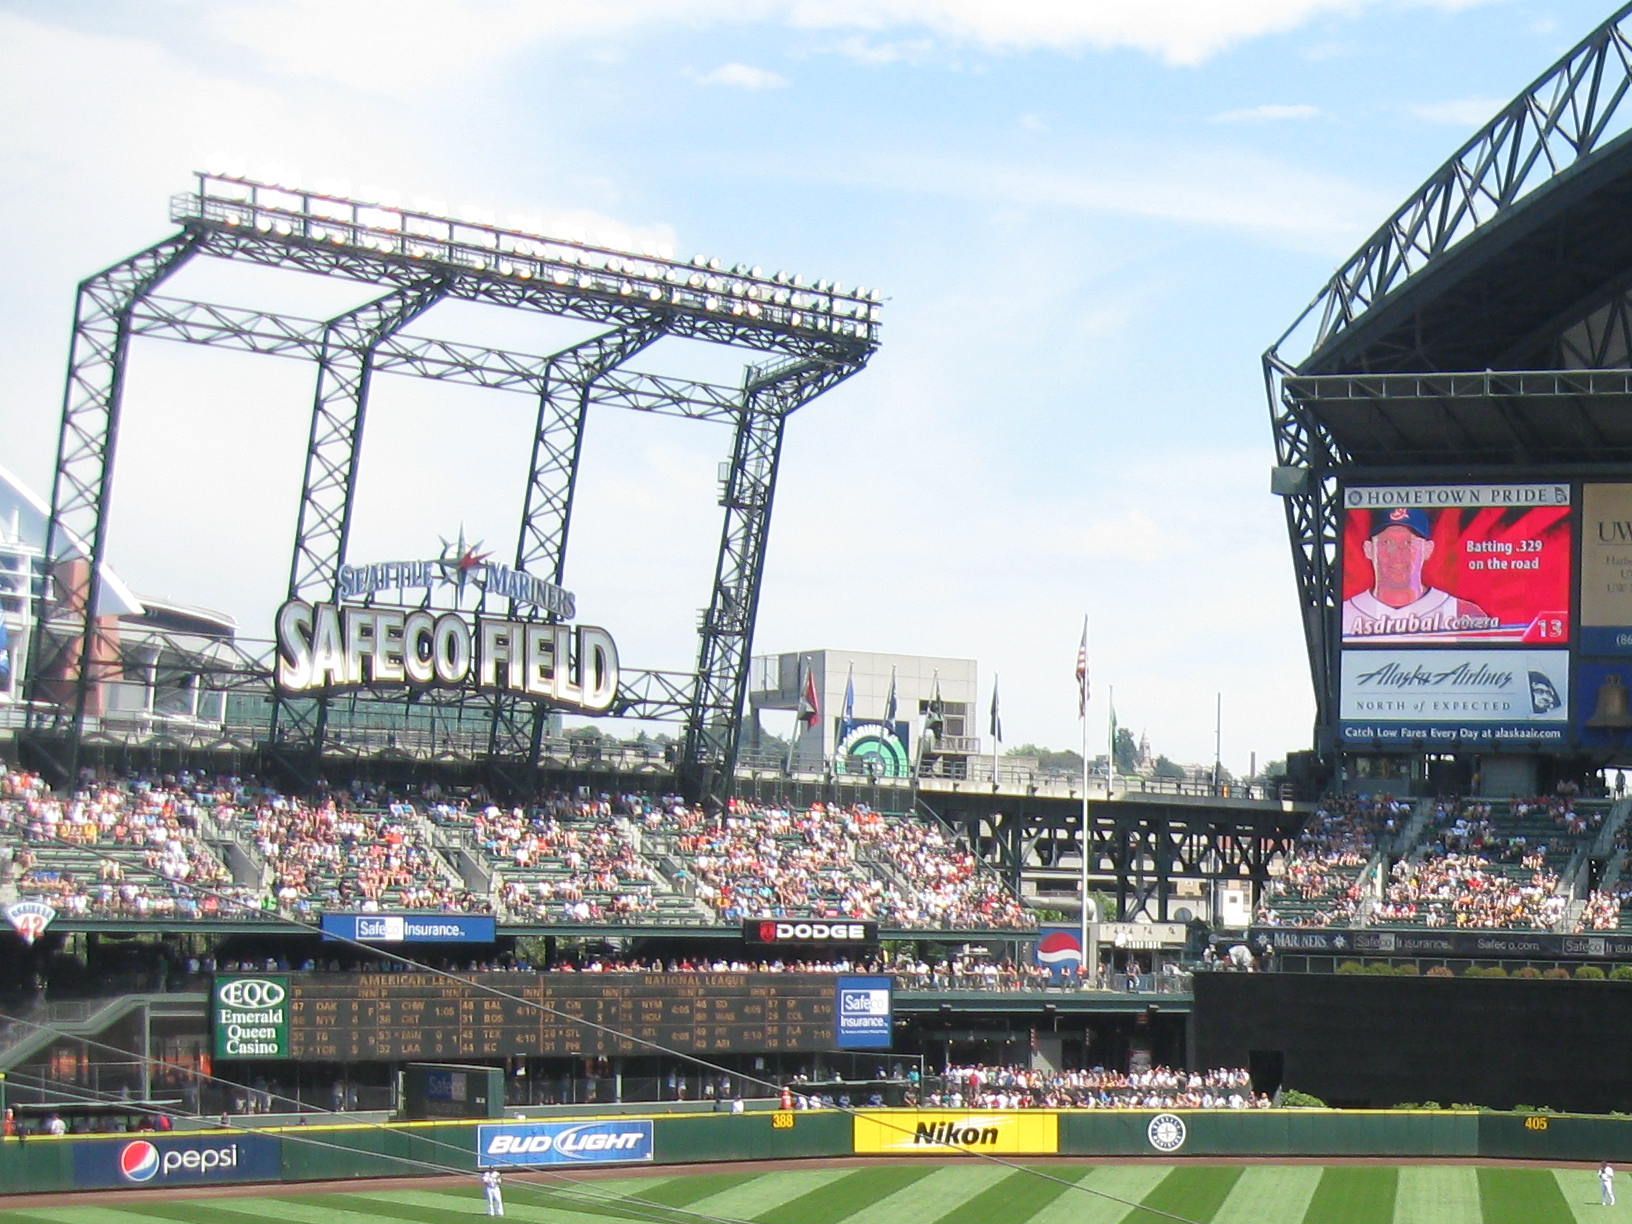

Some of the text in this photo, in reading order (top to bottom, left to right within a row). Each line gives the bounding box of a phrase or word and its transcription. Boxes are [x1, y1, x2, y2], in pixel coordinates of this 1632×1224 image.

[1368, 488, 1548, 505] HOMETOWN PRIDE
[1466, 540, 1543, 556] Batting .329
[1468, 558, 1539, 570] on the road
[338, 560, 576, 620] SEATTLE MARINERS
[1351, 613, 1441, 635] Asdrubal
[1538, 619, 1563, 638] 13
[275, 599, 620, 717] SAFECO FIELD
[1356, 662, 1512, 688] Alaska Airlines
[1357, 701, 1511, 713] NORTH of EXPECTED
[1345, 727, 1561, 741] Catch Low Fares Every Day at alaskaair.com
[360, 920, 459, 938] Safe Insurance
[776, 924, 865, 939] DODGE
[359, 975, 425, 987] AMERICAN
[644, 975, 745, 986] NATIONAL LEAGUE
[229, 982, 280, 1005] EQC
[221, 1009, 283, 1024] Emerald
[227, 1025, 277, 1041] Queen
[226, 1038, 278, 1055] Casino
[773, 1113, 793, 1128] 388
[1525, 1117, 1548, 1131] 405
[914, 1121, 998, 1145] Nikon
[487, 1132, 645, 1154] BUD LIGHT
[163, 1144, 238, 1175] pepsi
